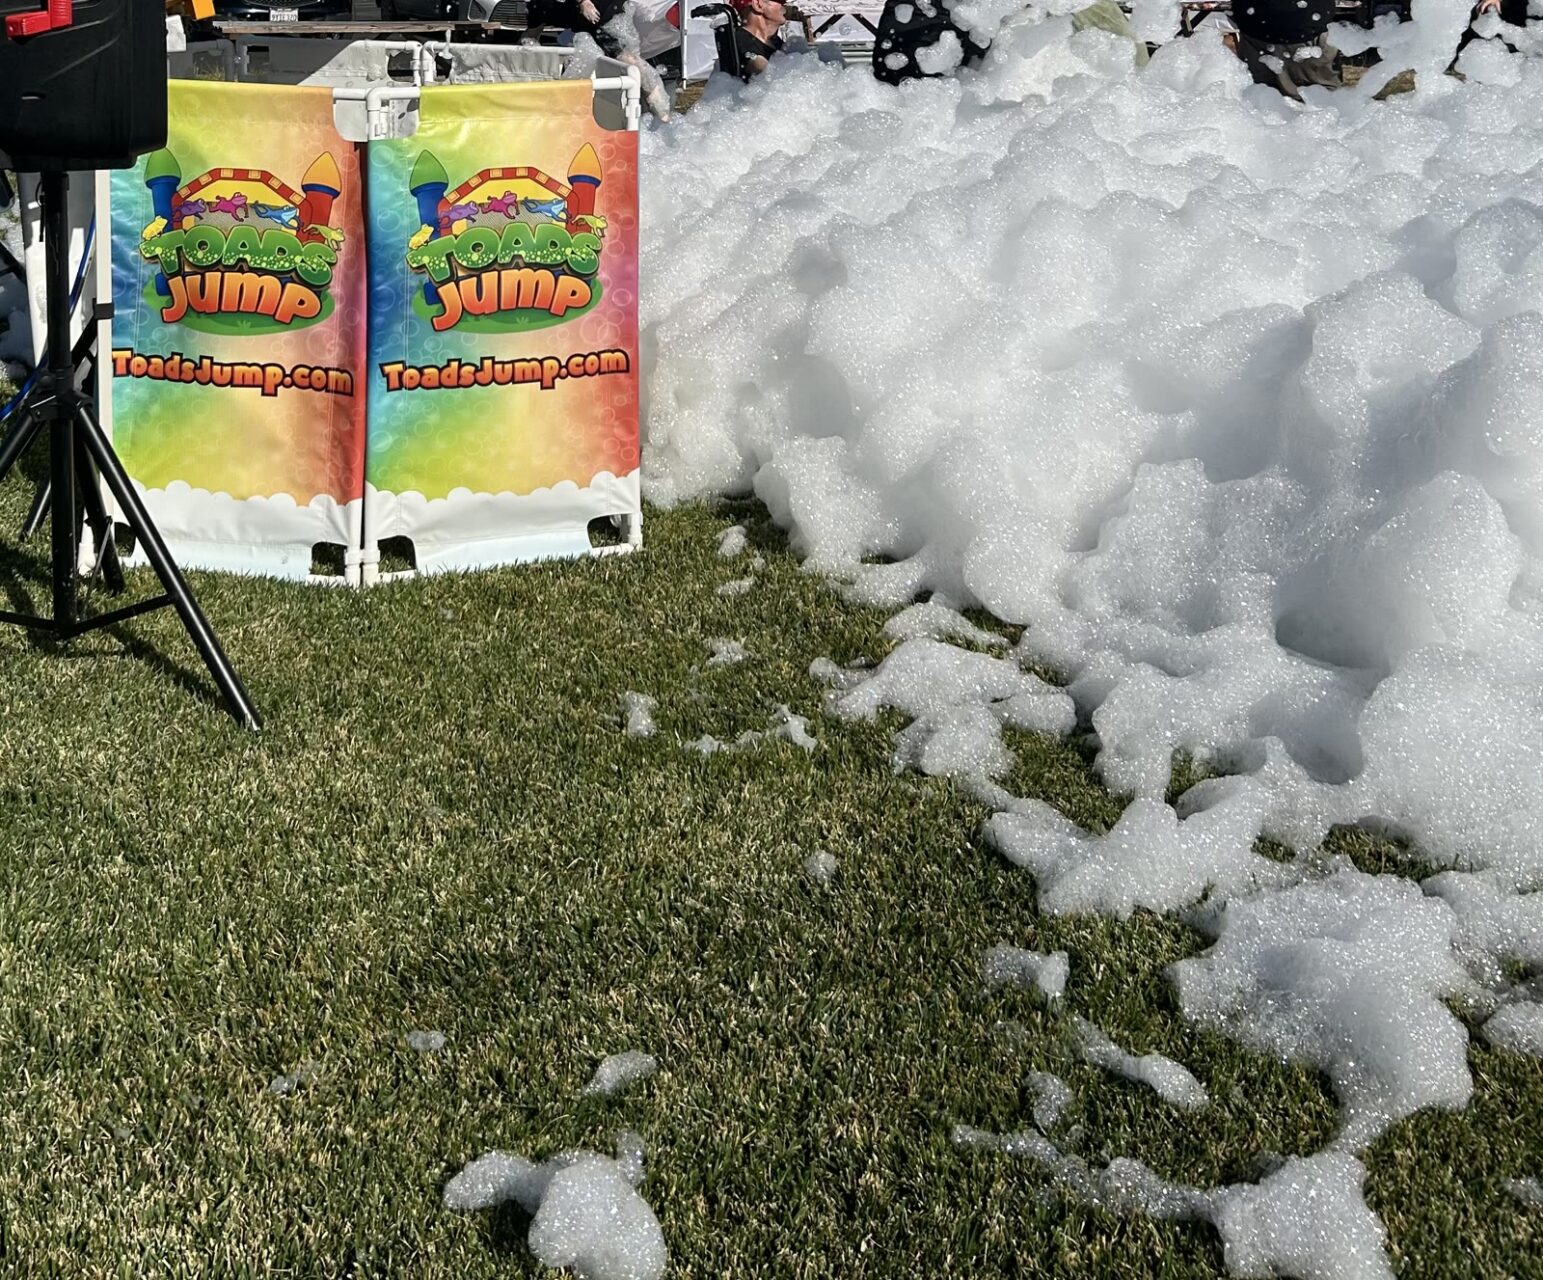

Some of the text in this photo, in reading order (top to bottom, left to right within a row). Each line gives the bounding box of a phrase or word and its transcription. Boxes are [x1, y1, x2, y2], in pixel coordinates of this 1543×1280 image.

[139, 225, 338, 287] TOADS
[406, 222, 602, 282] TOADS
[112, 348, 354, 396] ToadsJump.com
[379, 349, 630, 392] ToadsJump.com
